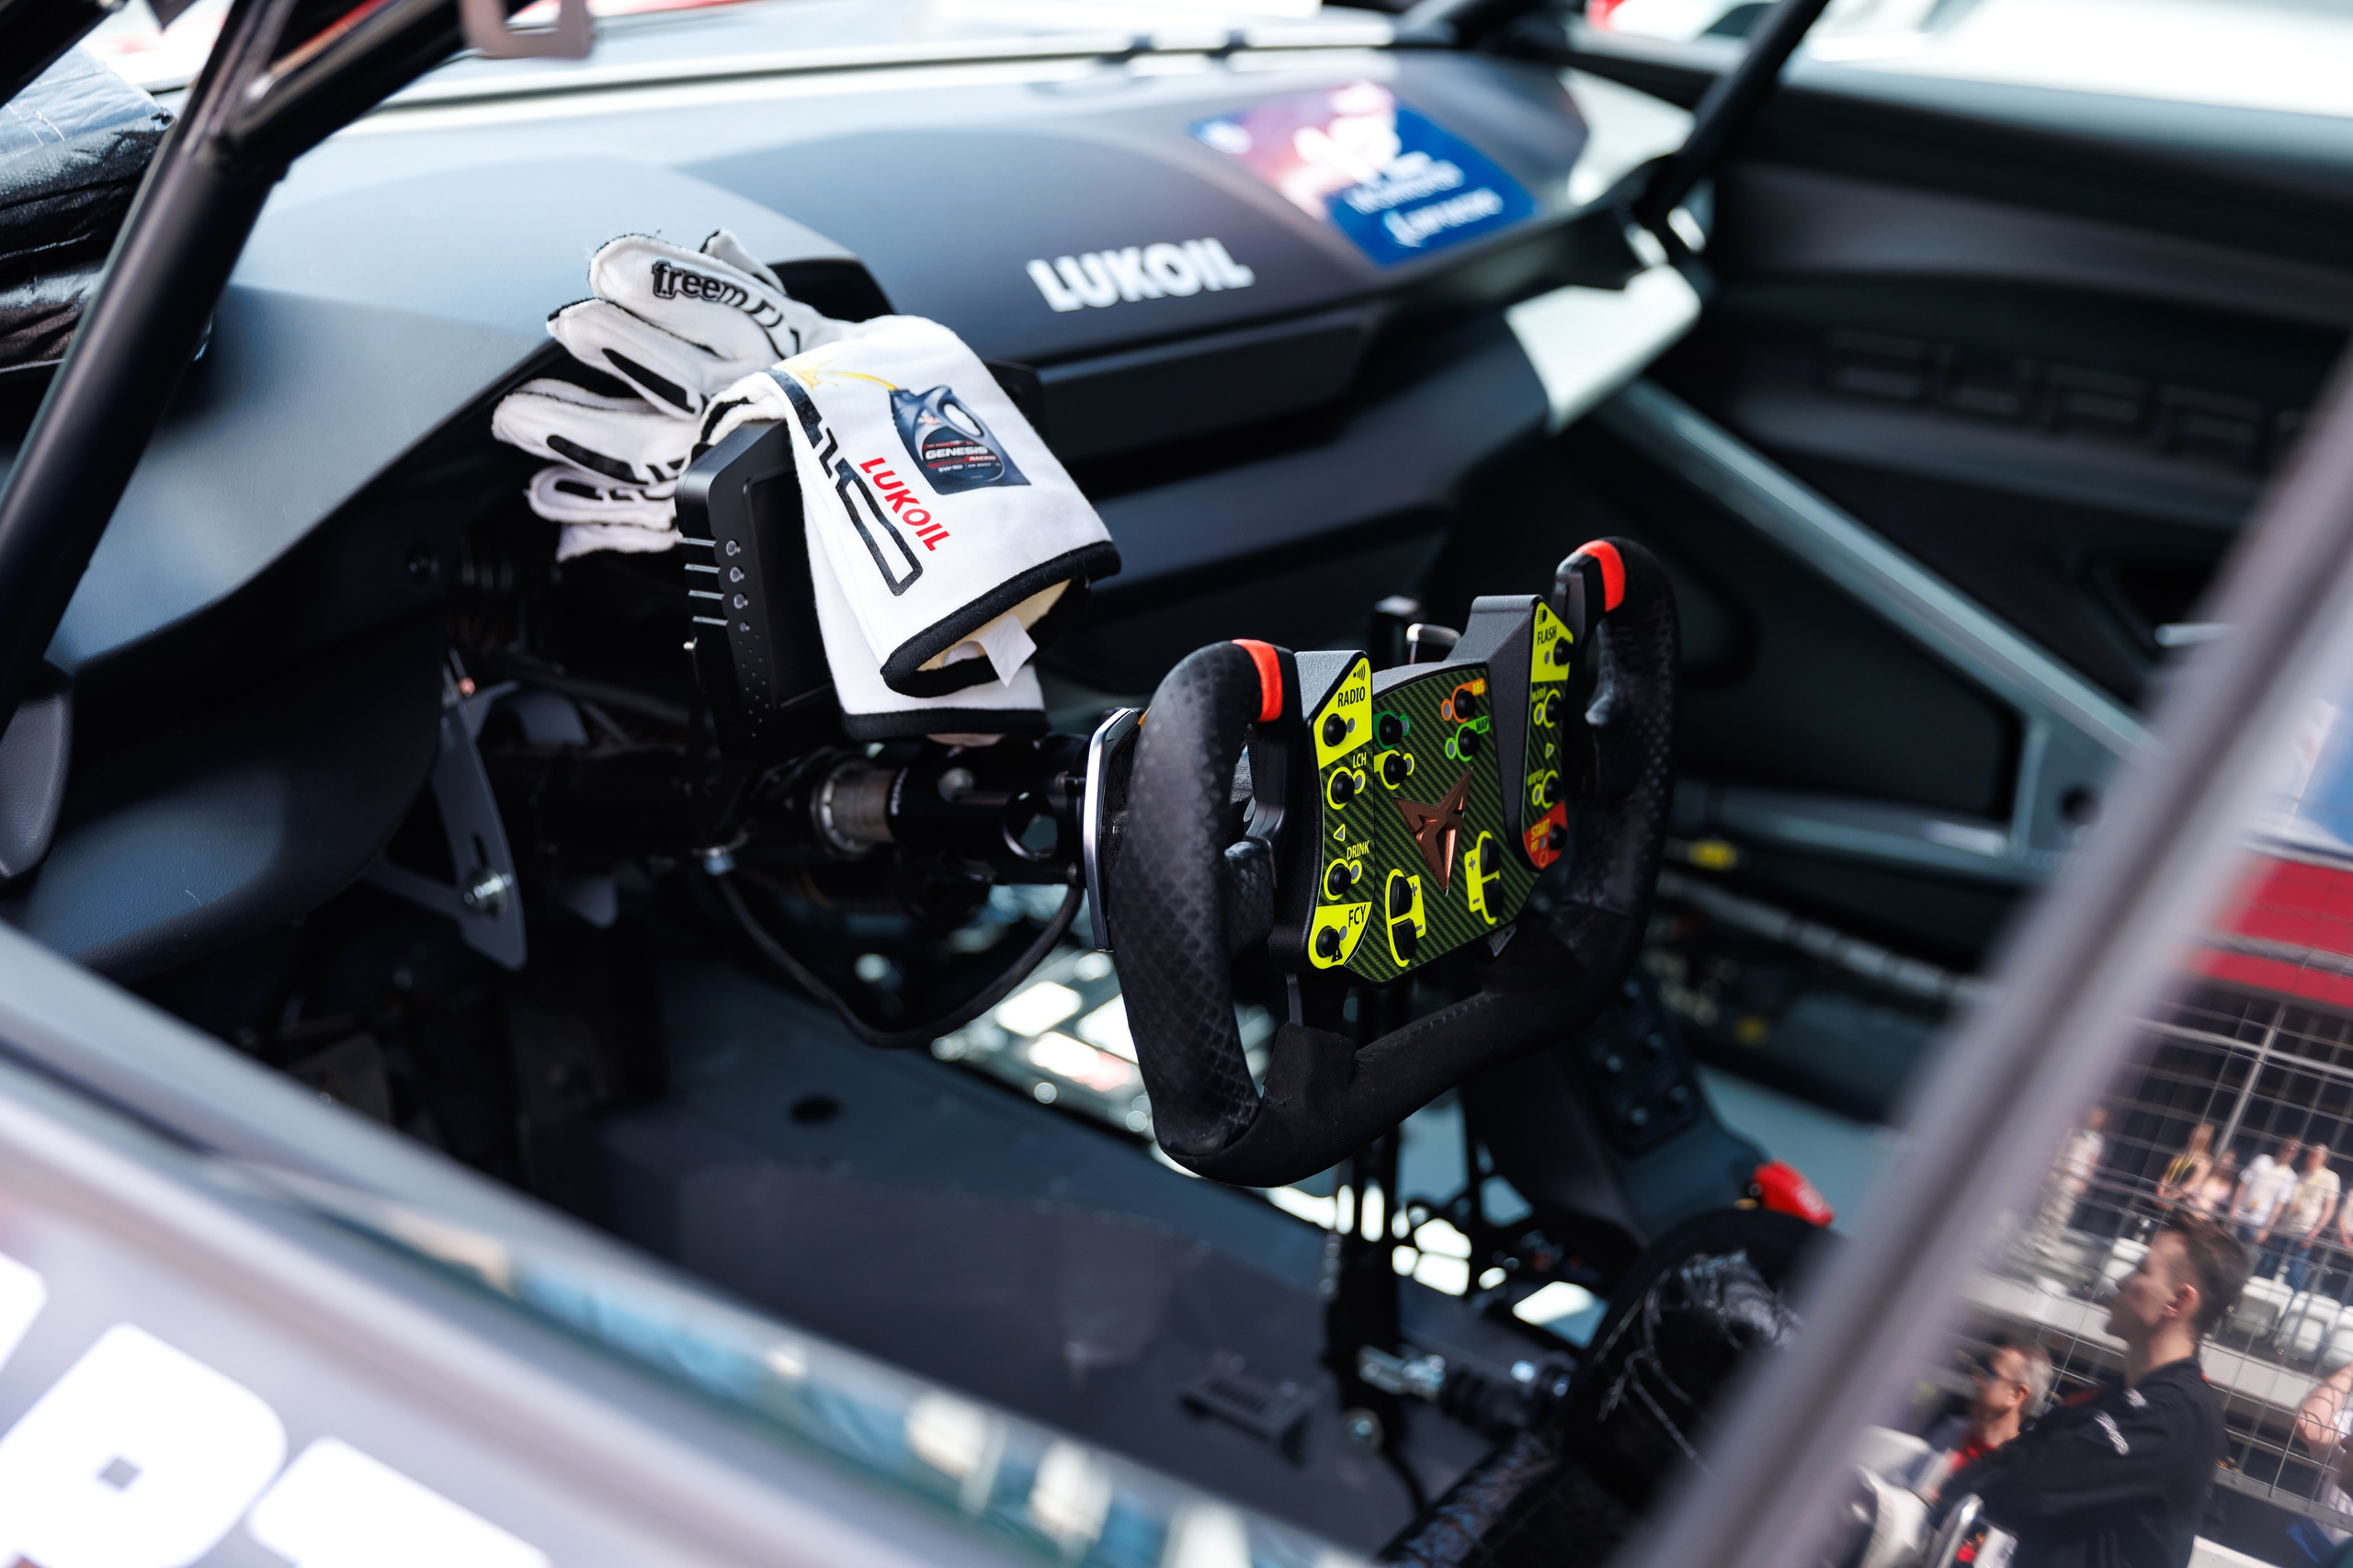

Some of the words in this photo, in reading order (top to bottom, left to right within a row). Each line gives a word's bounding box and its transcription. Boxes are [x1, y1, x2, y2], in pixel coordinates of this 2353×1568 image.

[652, 259, 749, 308] freem
[1026, 237, 1256, 312] LUKOIL
[926, 447, 988, 460] GENESIS
[858, 457, 951, 552] LUKOIL
[1537, 625, 1558, 645] FLASH
[1337, 686, 1366, 708] RADIO
[1472, 680, 1485, 696] ABS
[1475, 717, 1489, 733] MAP
[1352, 752, 1367, 768] LCH
[1347, 840, 1370, 860] DRINK
[1348, 903, 1367, 928] FCY
